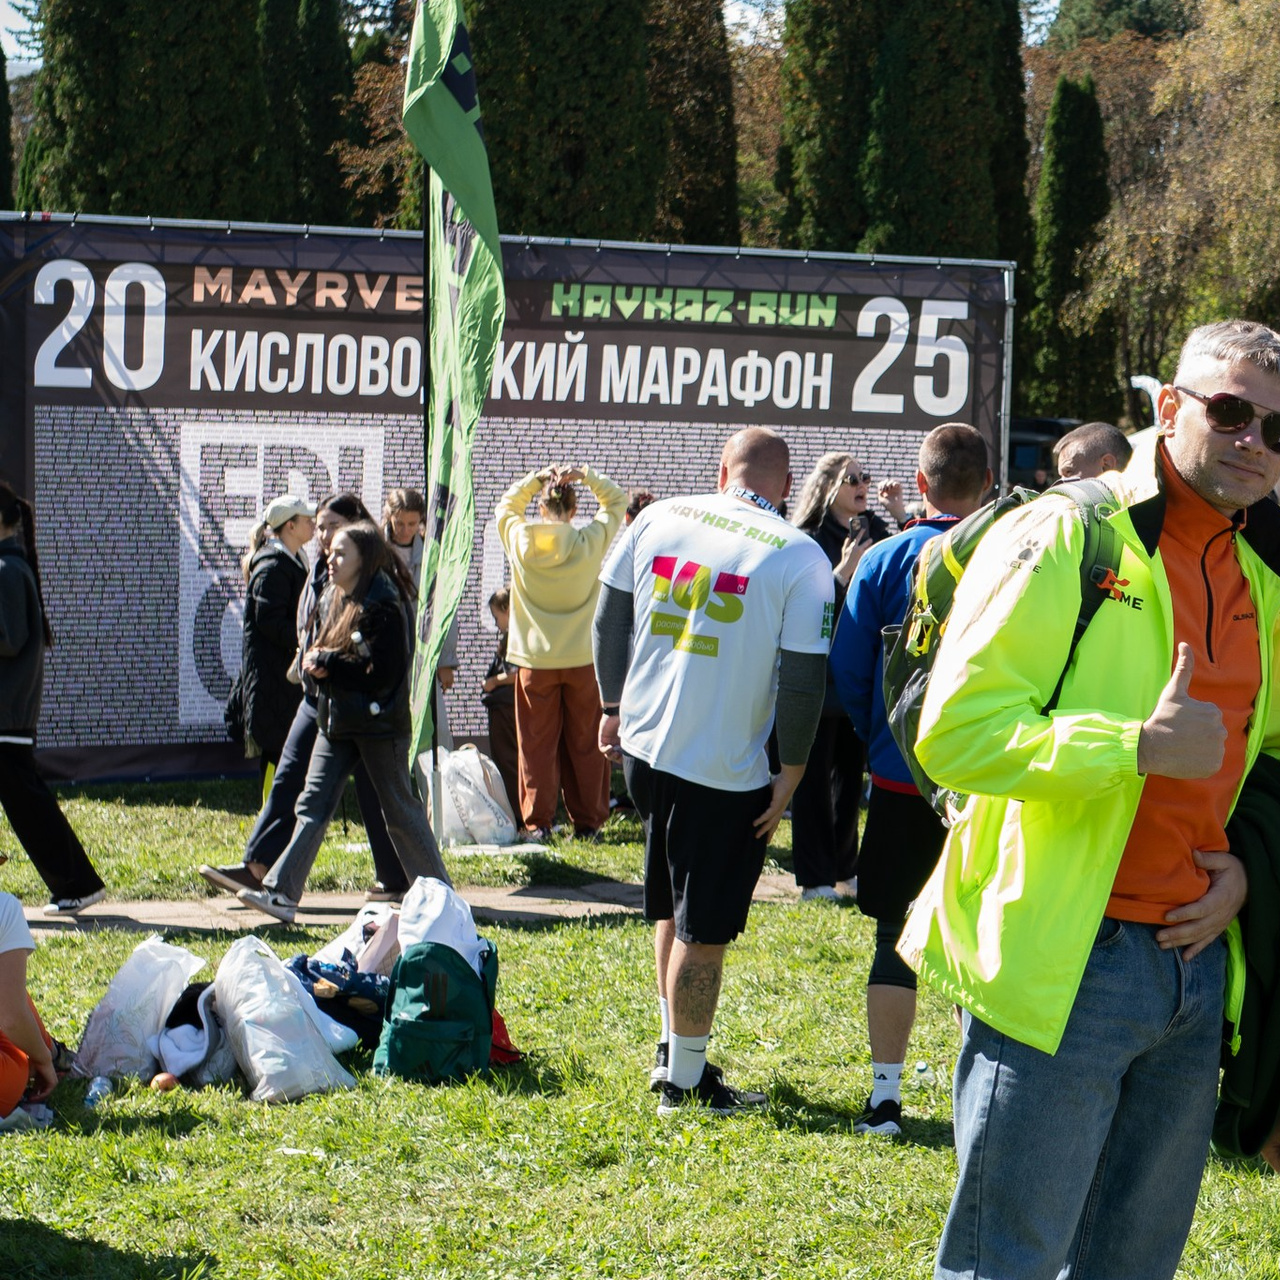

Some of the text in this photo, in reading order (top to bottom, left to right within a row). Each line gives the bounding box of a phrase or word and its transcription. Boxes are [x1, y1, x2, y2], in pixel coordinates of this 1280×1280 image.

[33, 258, 167, 391] 20
[190, 327, 833, 411] КИСЛОВОКИЙ МАРАФОН
[852, 296, 969, 417] 25
